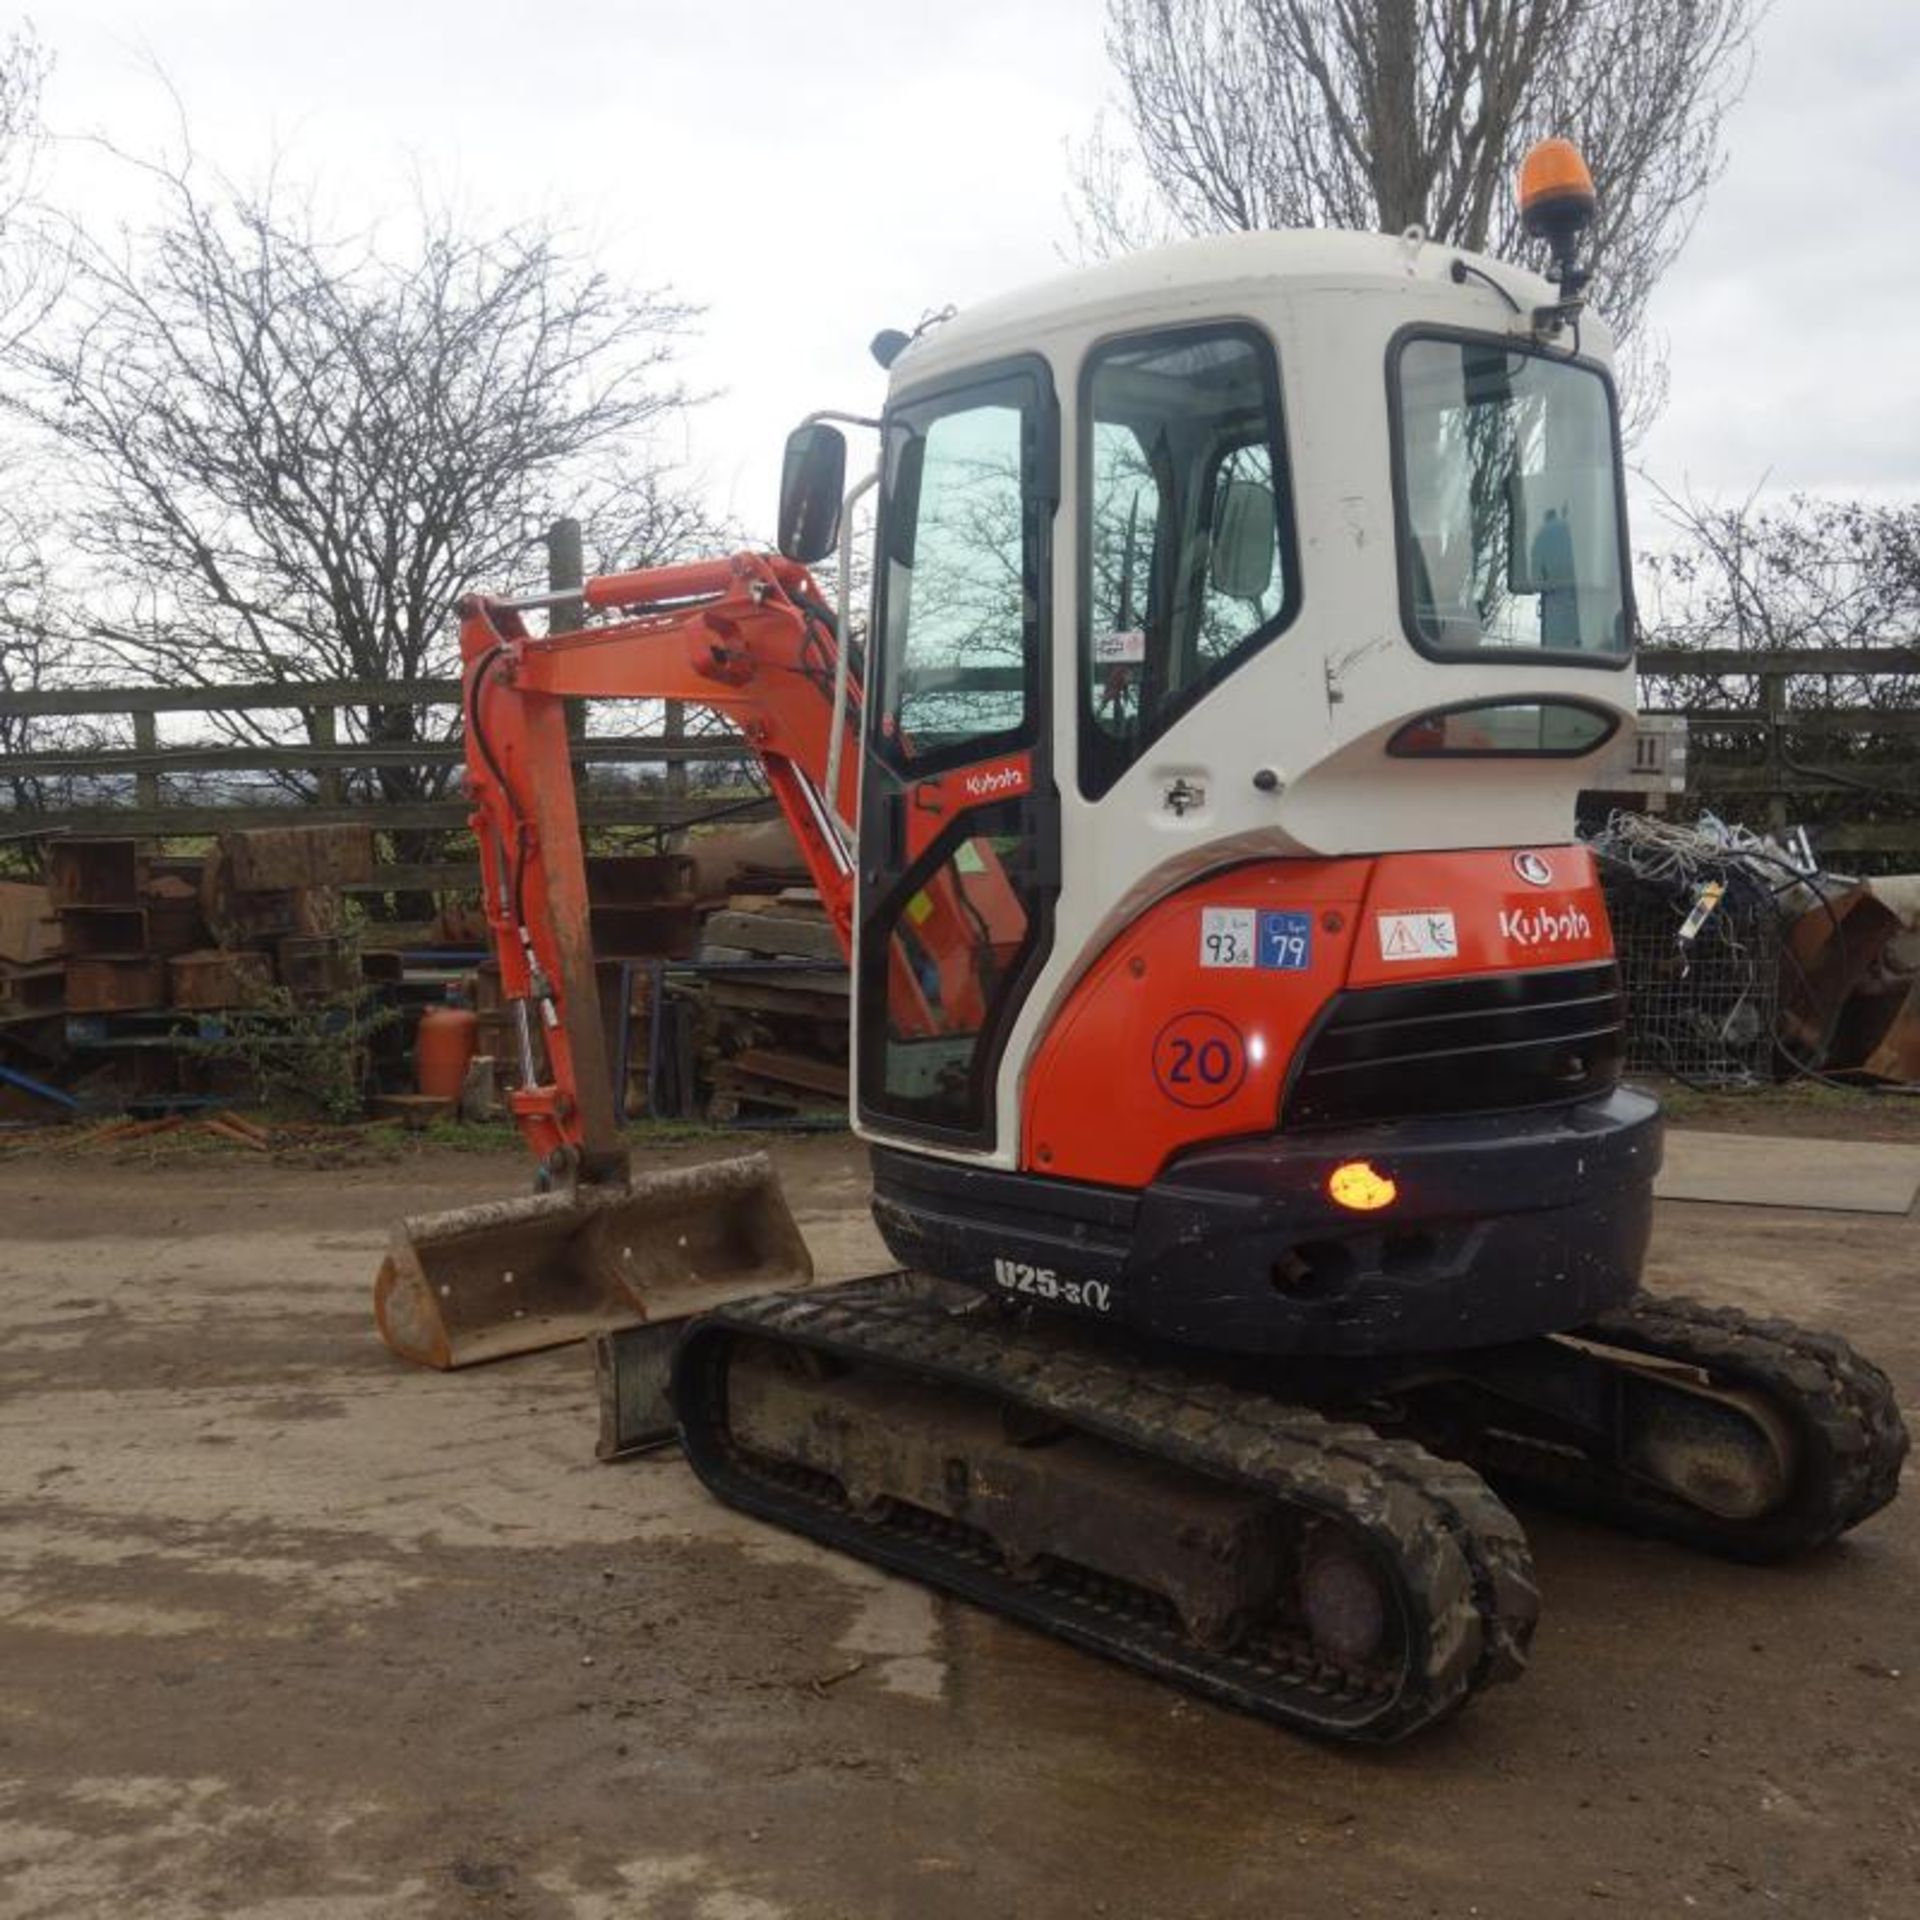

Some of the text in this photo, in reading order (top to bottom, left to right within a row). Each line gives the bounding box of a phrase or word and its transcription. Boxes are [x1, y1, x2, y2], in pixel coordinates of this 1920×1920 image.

[966, 768, 1023, 795] Kubota
[1499, 904, 1592, 945] Kubota
[1206, 933, 1236, 963] 93
[1271, 935, 1306, 967] 79
[1169, 1037, 1231, 1085] 20
